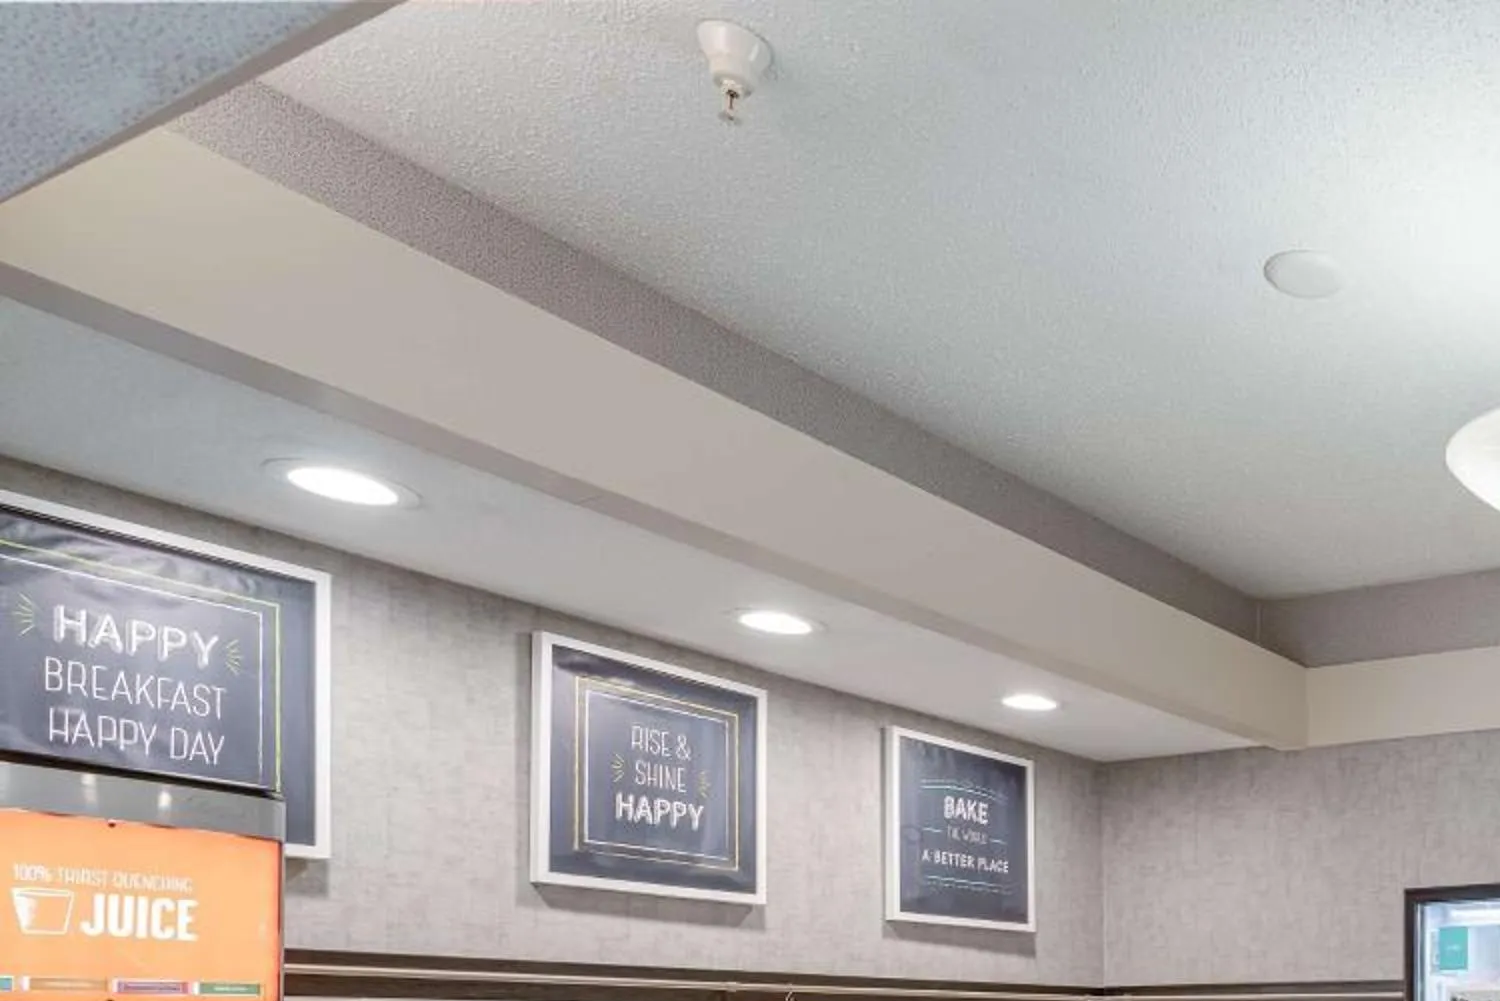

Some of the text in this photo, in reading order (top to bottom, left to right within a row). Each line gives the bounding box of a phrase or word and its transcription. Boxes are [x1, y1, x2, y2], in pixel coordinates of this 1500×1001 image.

[53, 604, 219, 668] HAPPY
[44, 655, 227, 721] BREAKFAST
[49, 706, 225, 766] HAPPY DAY
[631, 725, 692, 761] RISE &
[635, 760, 687, 793] SHINE
[615, 791, 705, 832] HAPPY
[943, 795, 989, 826] BAKE
[933, 850, 975, 869] BETTER
[977, 856, 1009, 875] PLACE
[80, 892, 199, 942] JUICE
